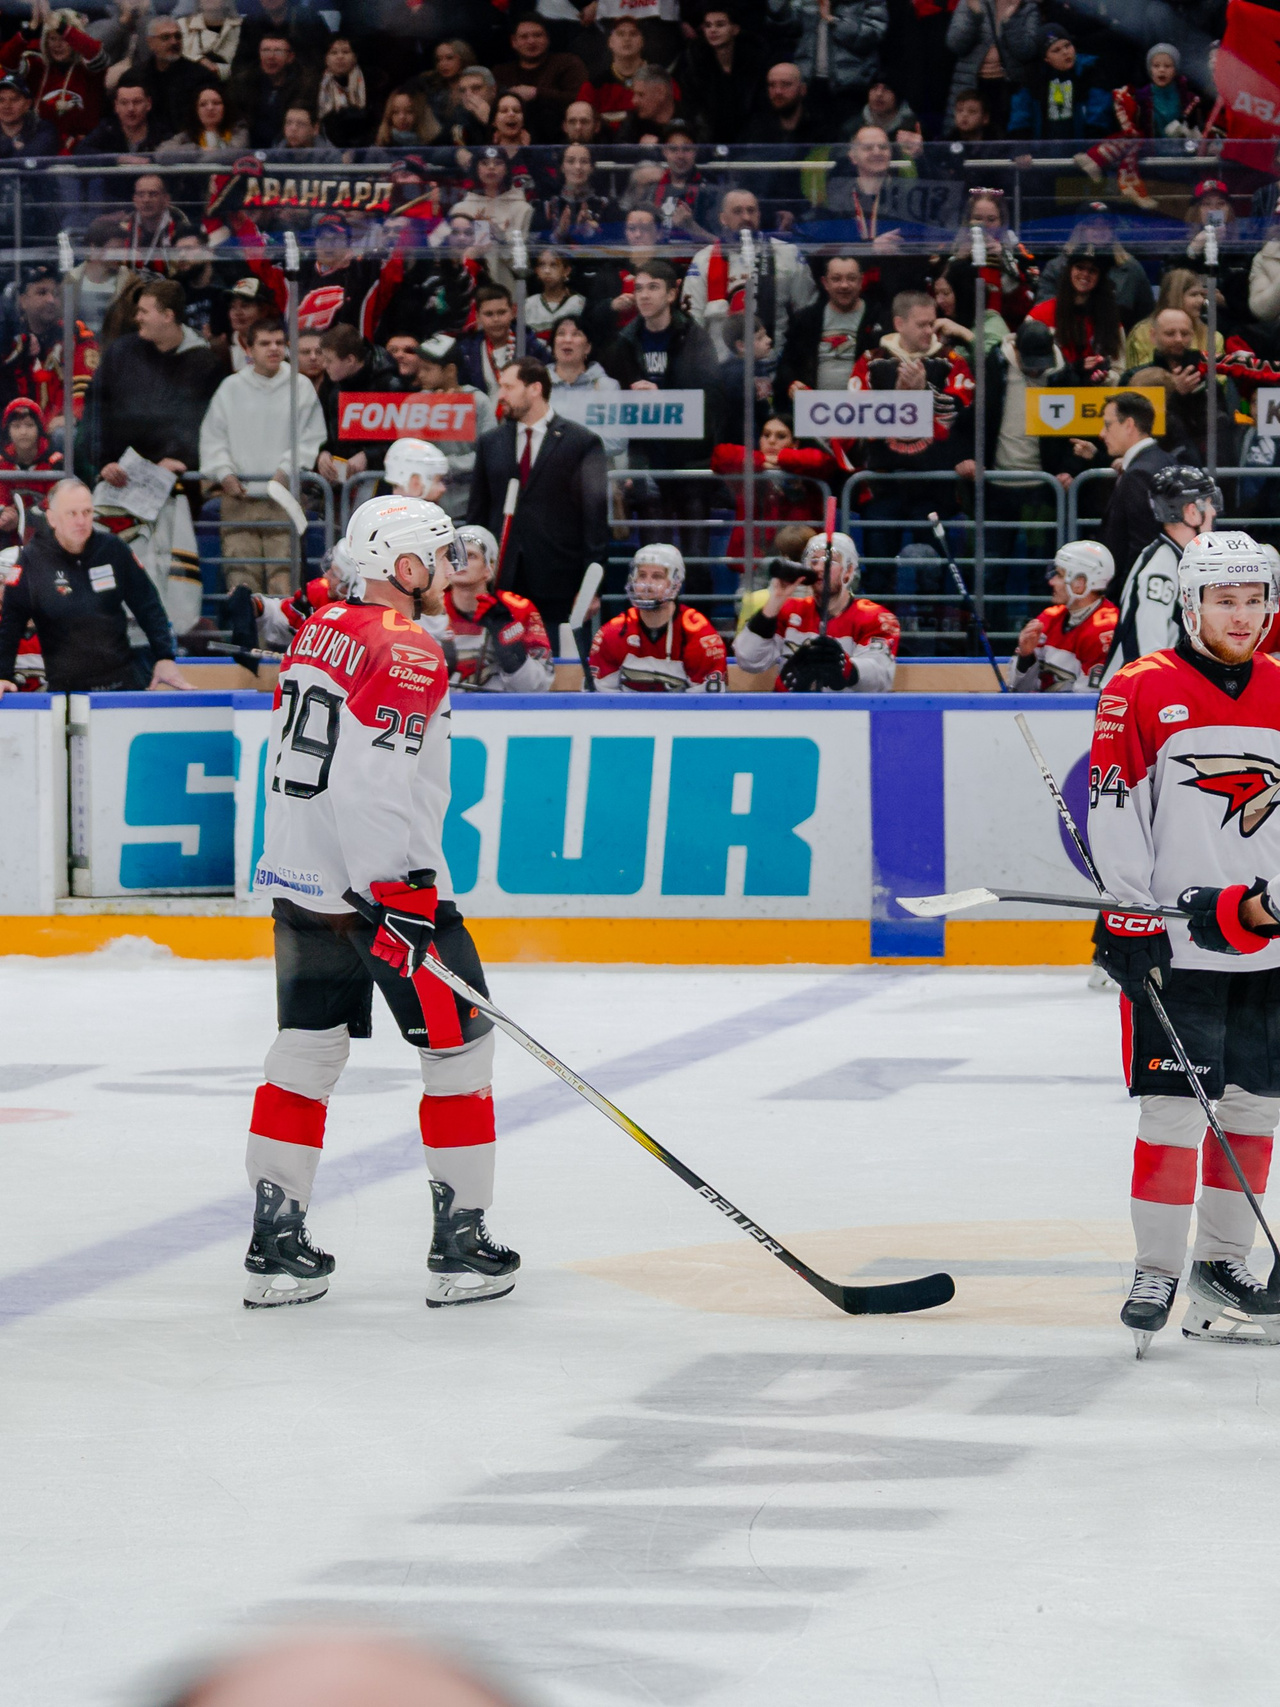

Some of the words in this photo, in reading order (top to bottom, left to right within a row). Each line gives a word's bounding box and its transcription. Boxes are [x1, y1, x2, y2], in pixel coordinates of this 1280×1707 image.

[243, 177, 394, 213] АВАНГАРД
[342, 402, 473, 430] FONBET
[585, 402, 685, 425] SIBUR
[809, 402, 919, 425] согаз
[1226, 539, 1250, 550] 84
[1227, 565, 1260, 574] согаз
[1148, 576, 1176, 605] 96
[286, 623, 366, 677] BLUKOV
[372, 705, 426, 756] 29
[120, 731, 819, 896] SUR
[278, 867, 298, 880] СЕТЬ
[299, 873, 319, 883] АЗС
[1107, 914, 1166, 932] CCM
[525, 1041, 585, 1092] HYP2RLITE
[698, 1185, 783, 1255] BAUER
[296, 1255, 316, 1268] BAUER
[1211, 1280, 1241, 1303] BAUER
